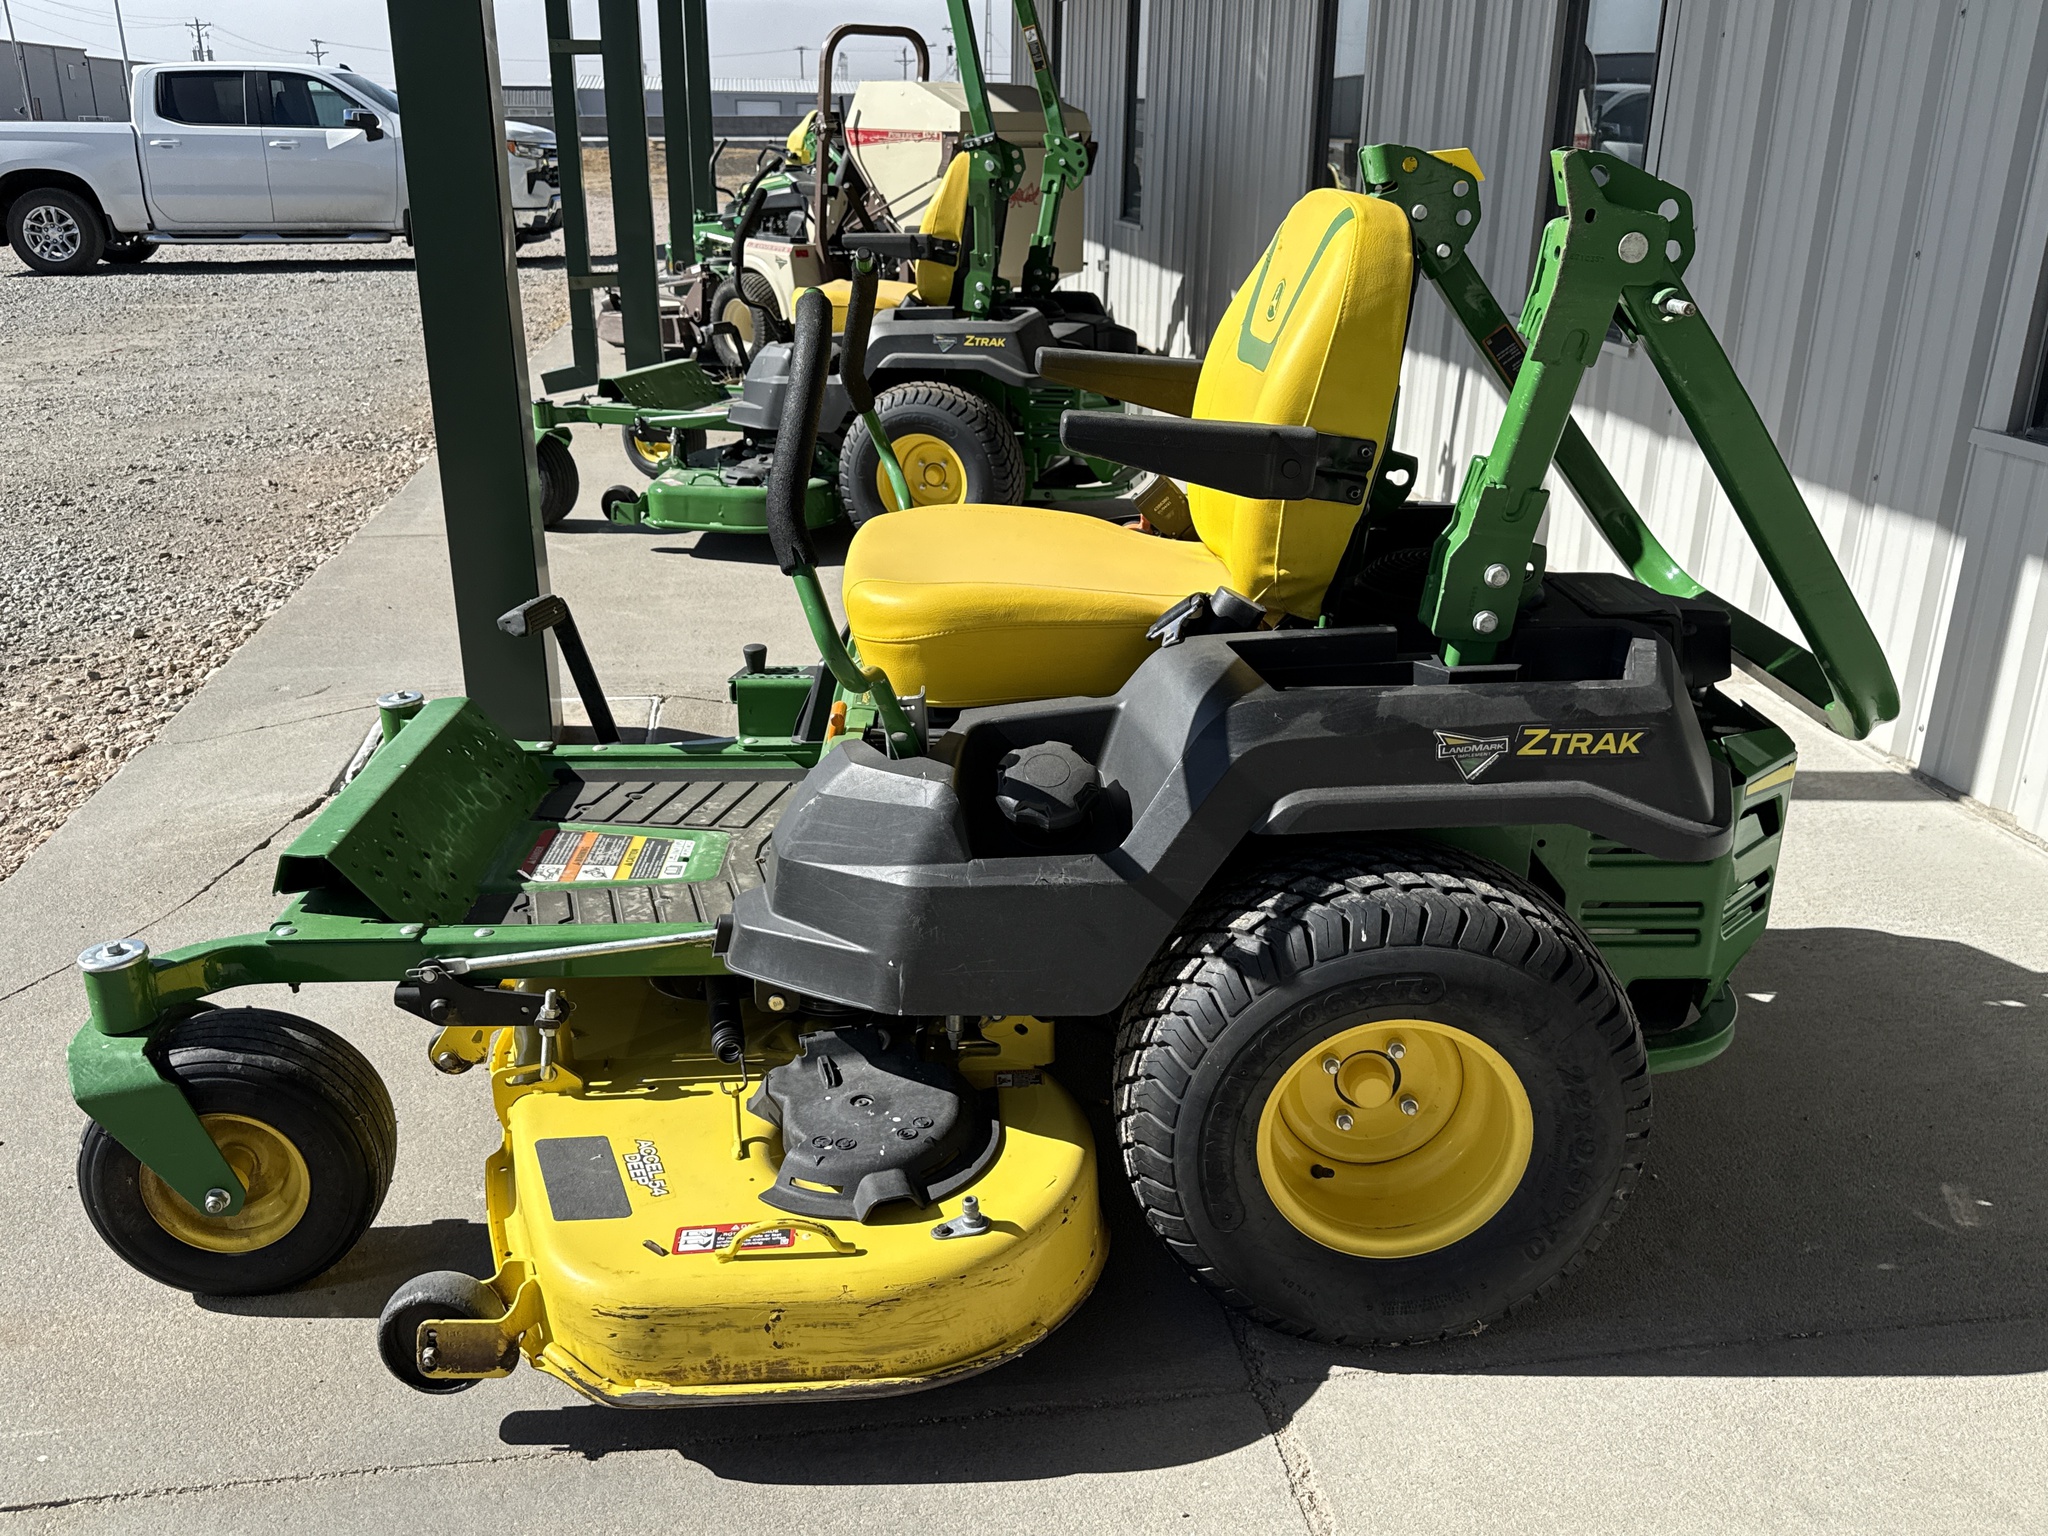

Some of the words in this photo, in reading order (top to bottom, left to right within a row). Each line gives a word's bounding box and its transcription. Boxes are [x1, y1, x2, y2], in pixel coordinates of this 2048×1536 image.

[963, 335, 1006, 348] ZTRAK
[1516, 728, 1645, 756] ZTRAK
[623, 1154, 649, 1186] DEEP
[635, 1139, 665, 1180] ACCEL
